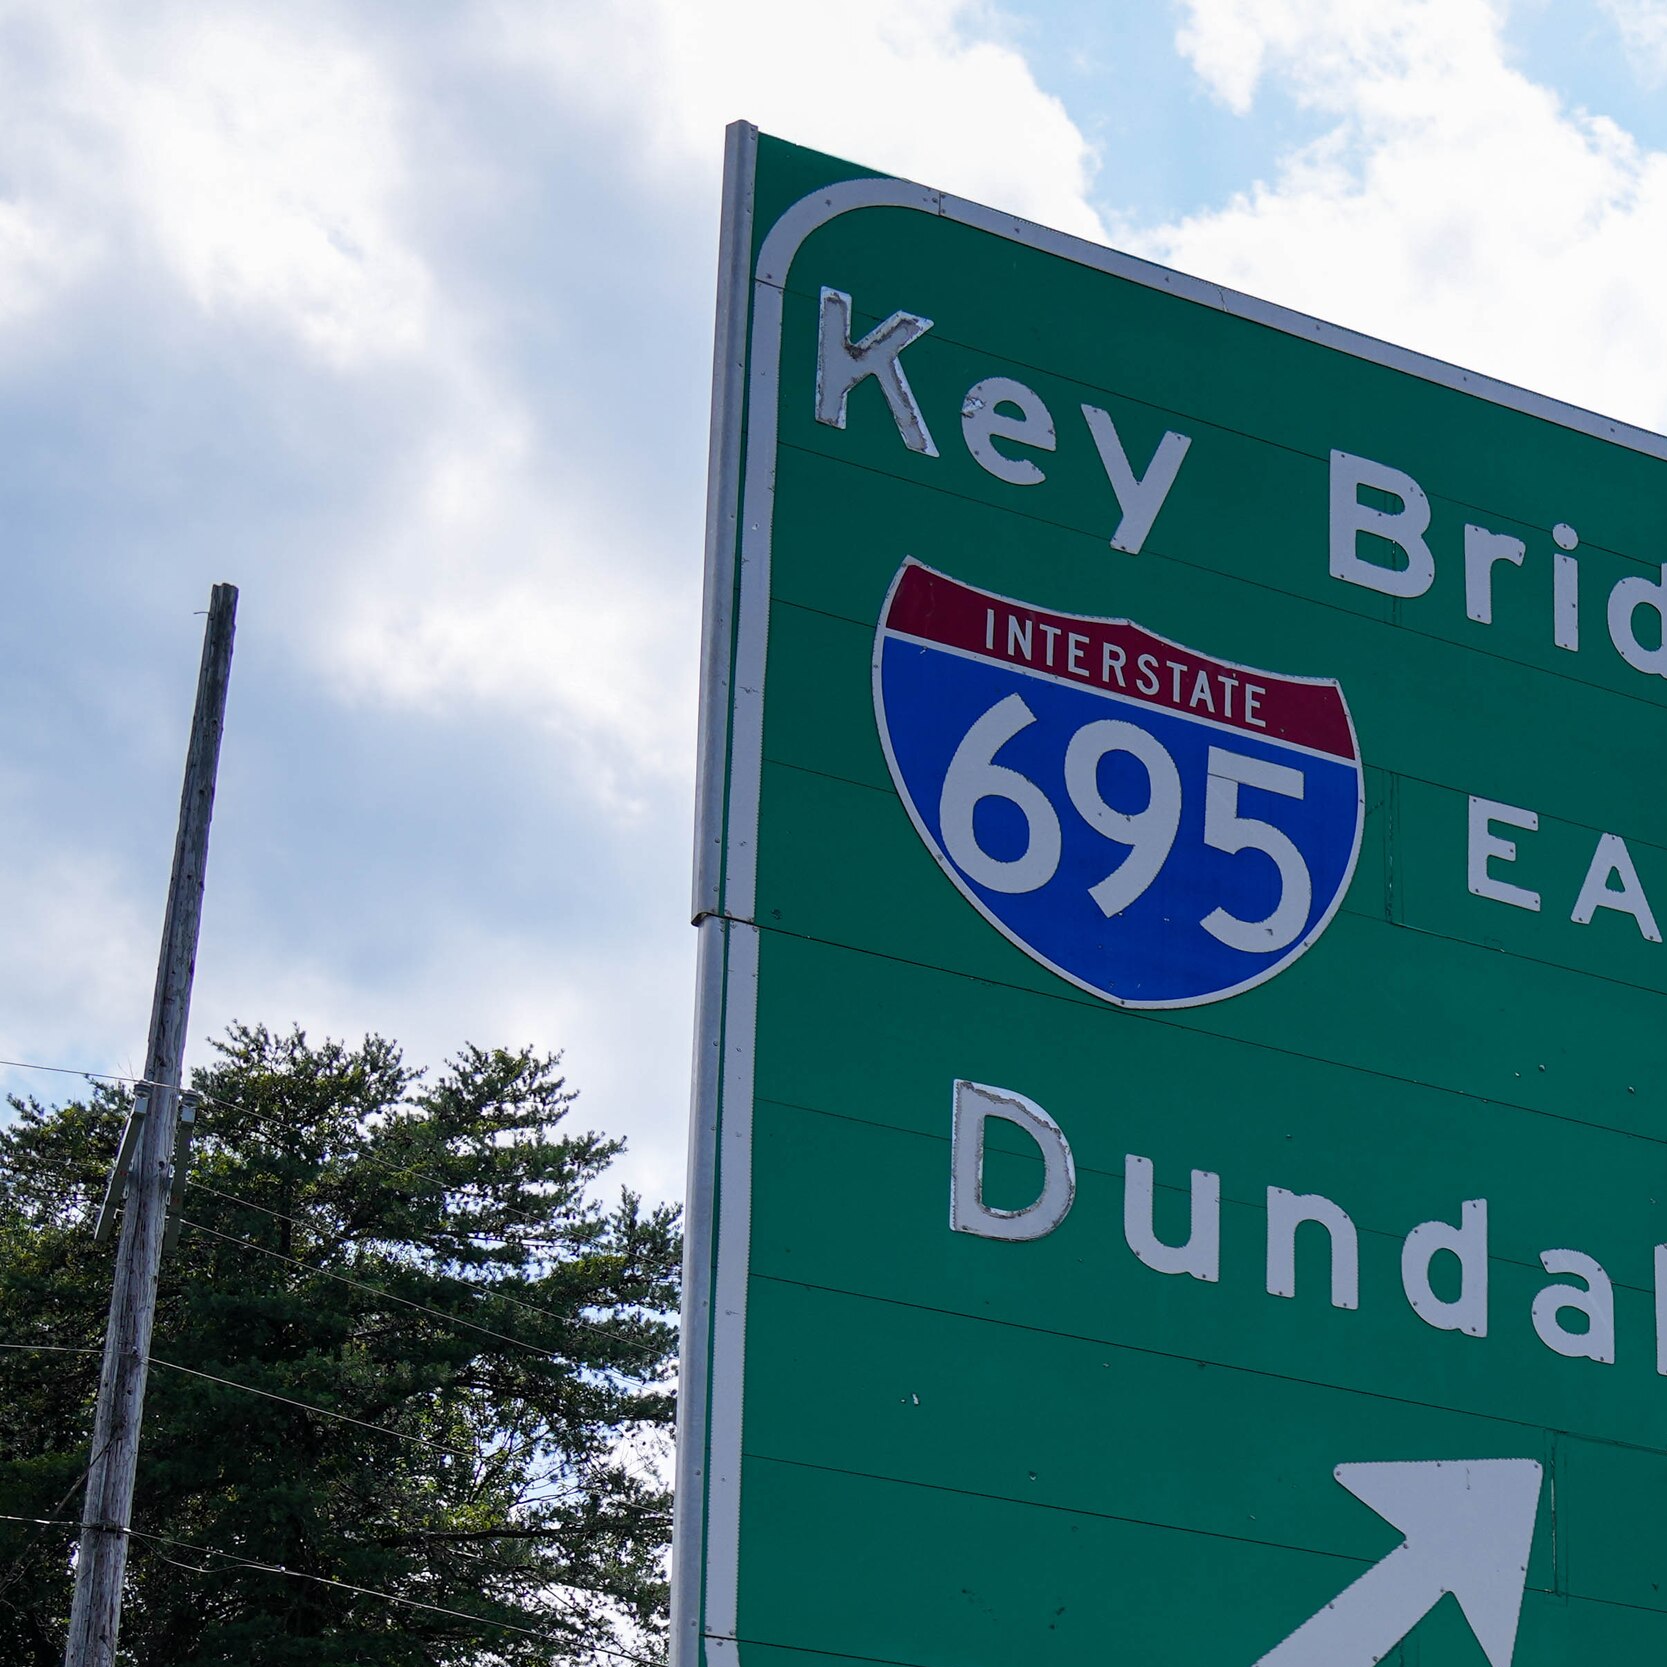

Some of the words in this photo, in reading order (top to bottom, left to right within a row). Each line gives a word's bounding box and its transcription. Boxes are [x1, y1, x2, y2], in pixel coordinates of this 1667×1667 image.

[815, 285, 1193, 556] Key
[986, 608, 1267, 728] INTERSTATE
[938, 692, 1313, 954] 695
